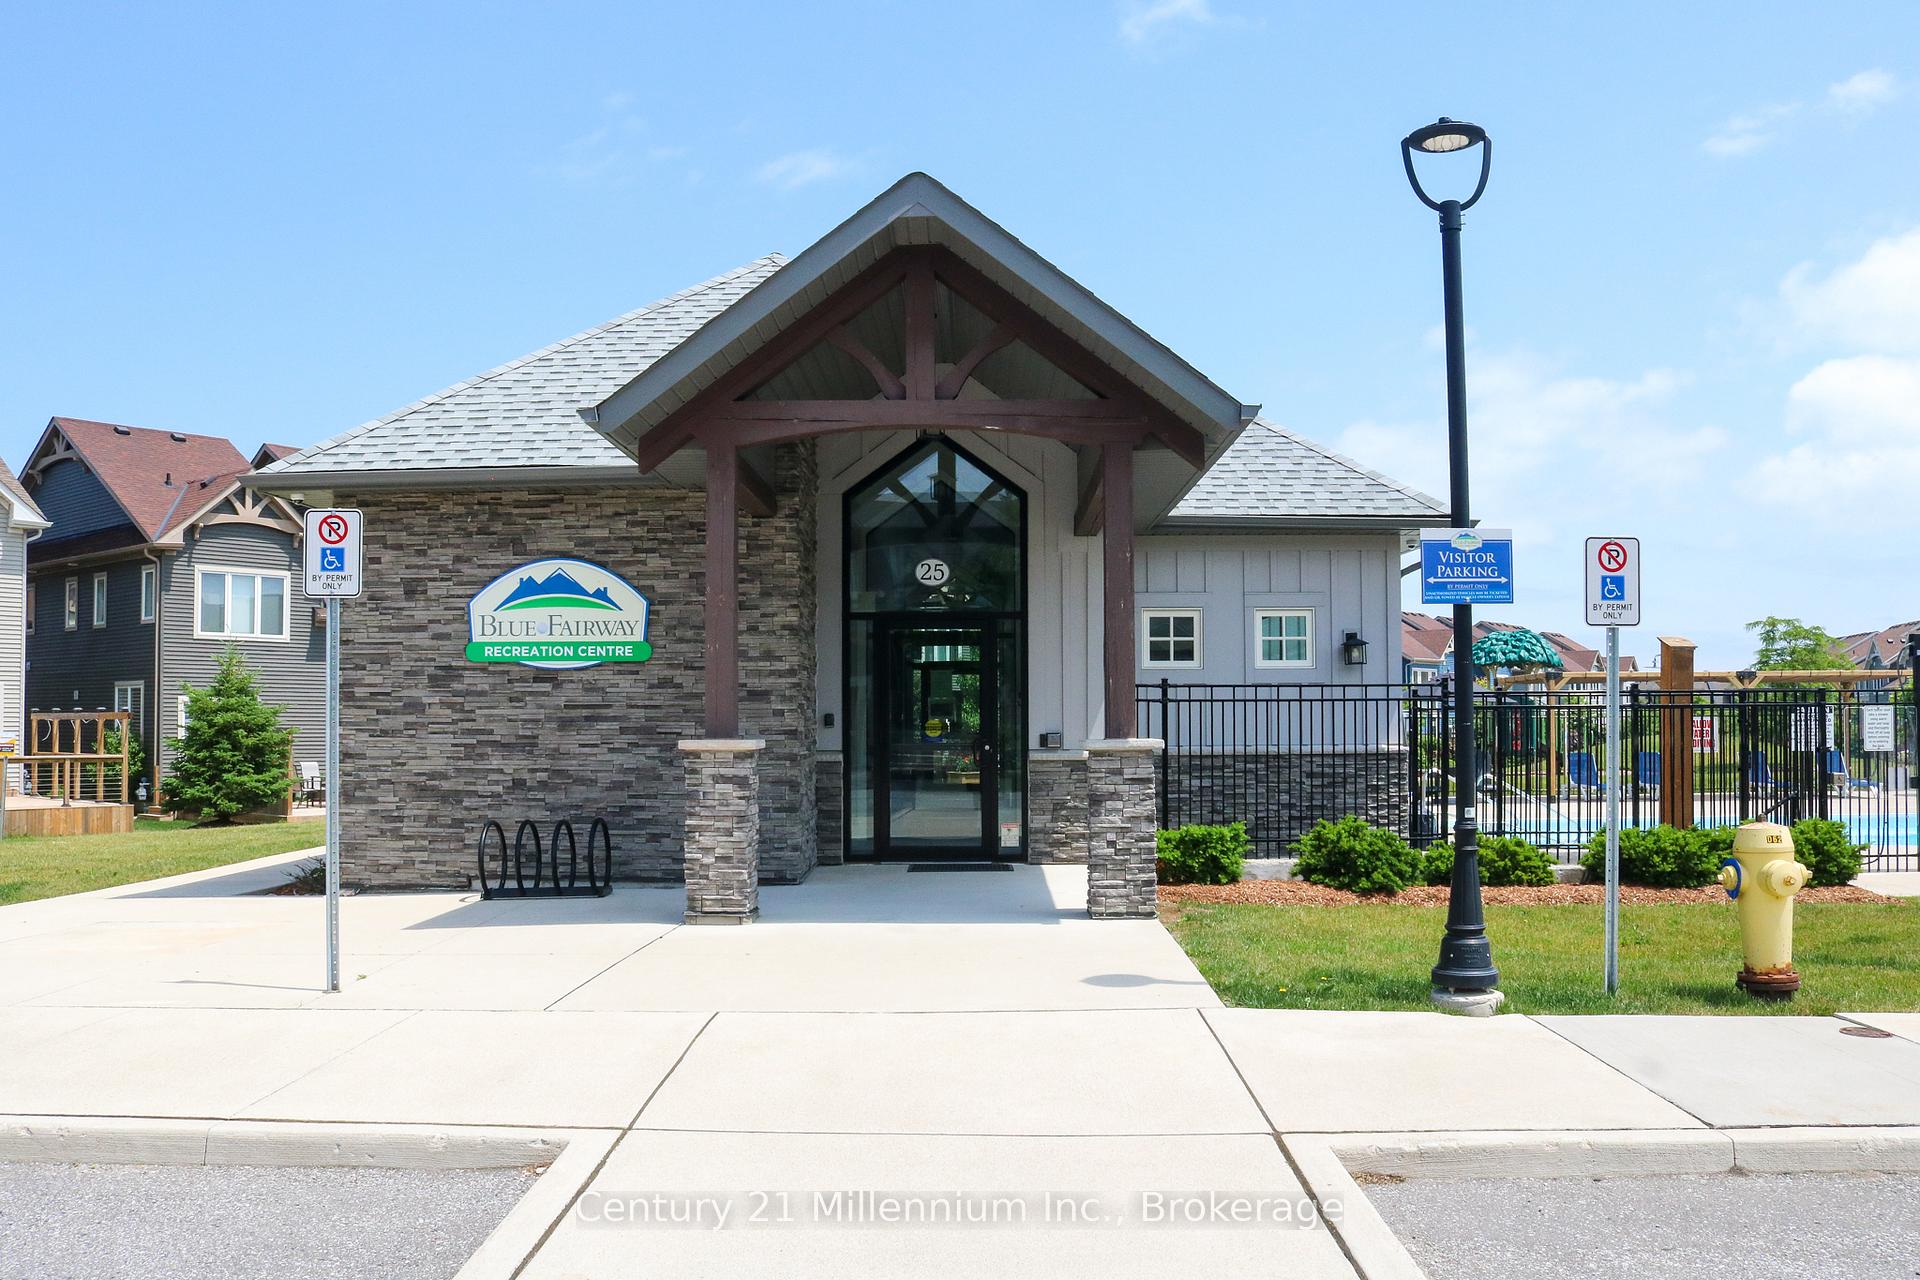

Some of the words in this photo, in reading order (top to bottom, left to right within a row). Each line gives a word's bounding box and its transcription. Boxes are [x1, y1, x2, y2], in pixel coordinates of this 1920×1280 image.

[1438, 551, 1496, 563] VISITOR
[921, 563, 944, 580] 25
[1437, 565, 1498, 577] PARKING
[312, 574, 323, 582] BY
[326, 574, 353, 582] PERMIT
[322, 582, 343, 590] ONLY
[479, 614, 536, 637] BLUE
[548, 614, 639, 637] FAIRWAY
[484, 645, 574, 657] RECREATION
[578, 645, 633, 657] CENTRE
[1694, 729, 1711, 739] ATER
